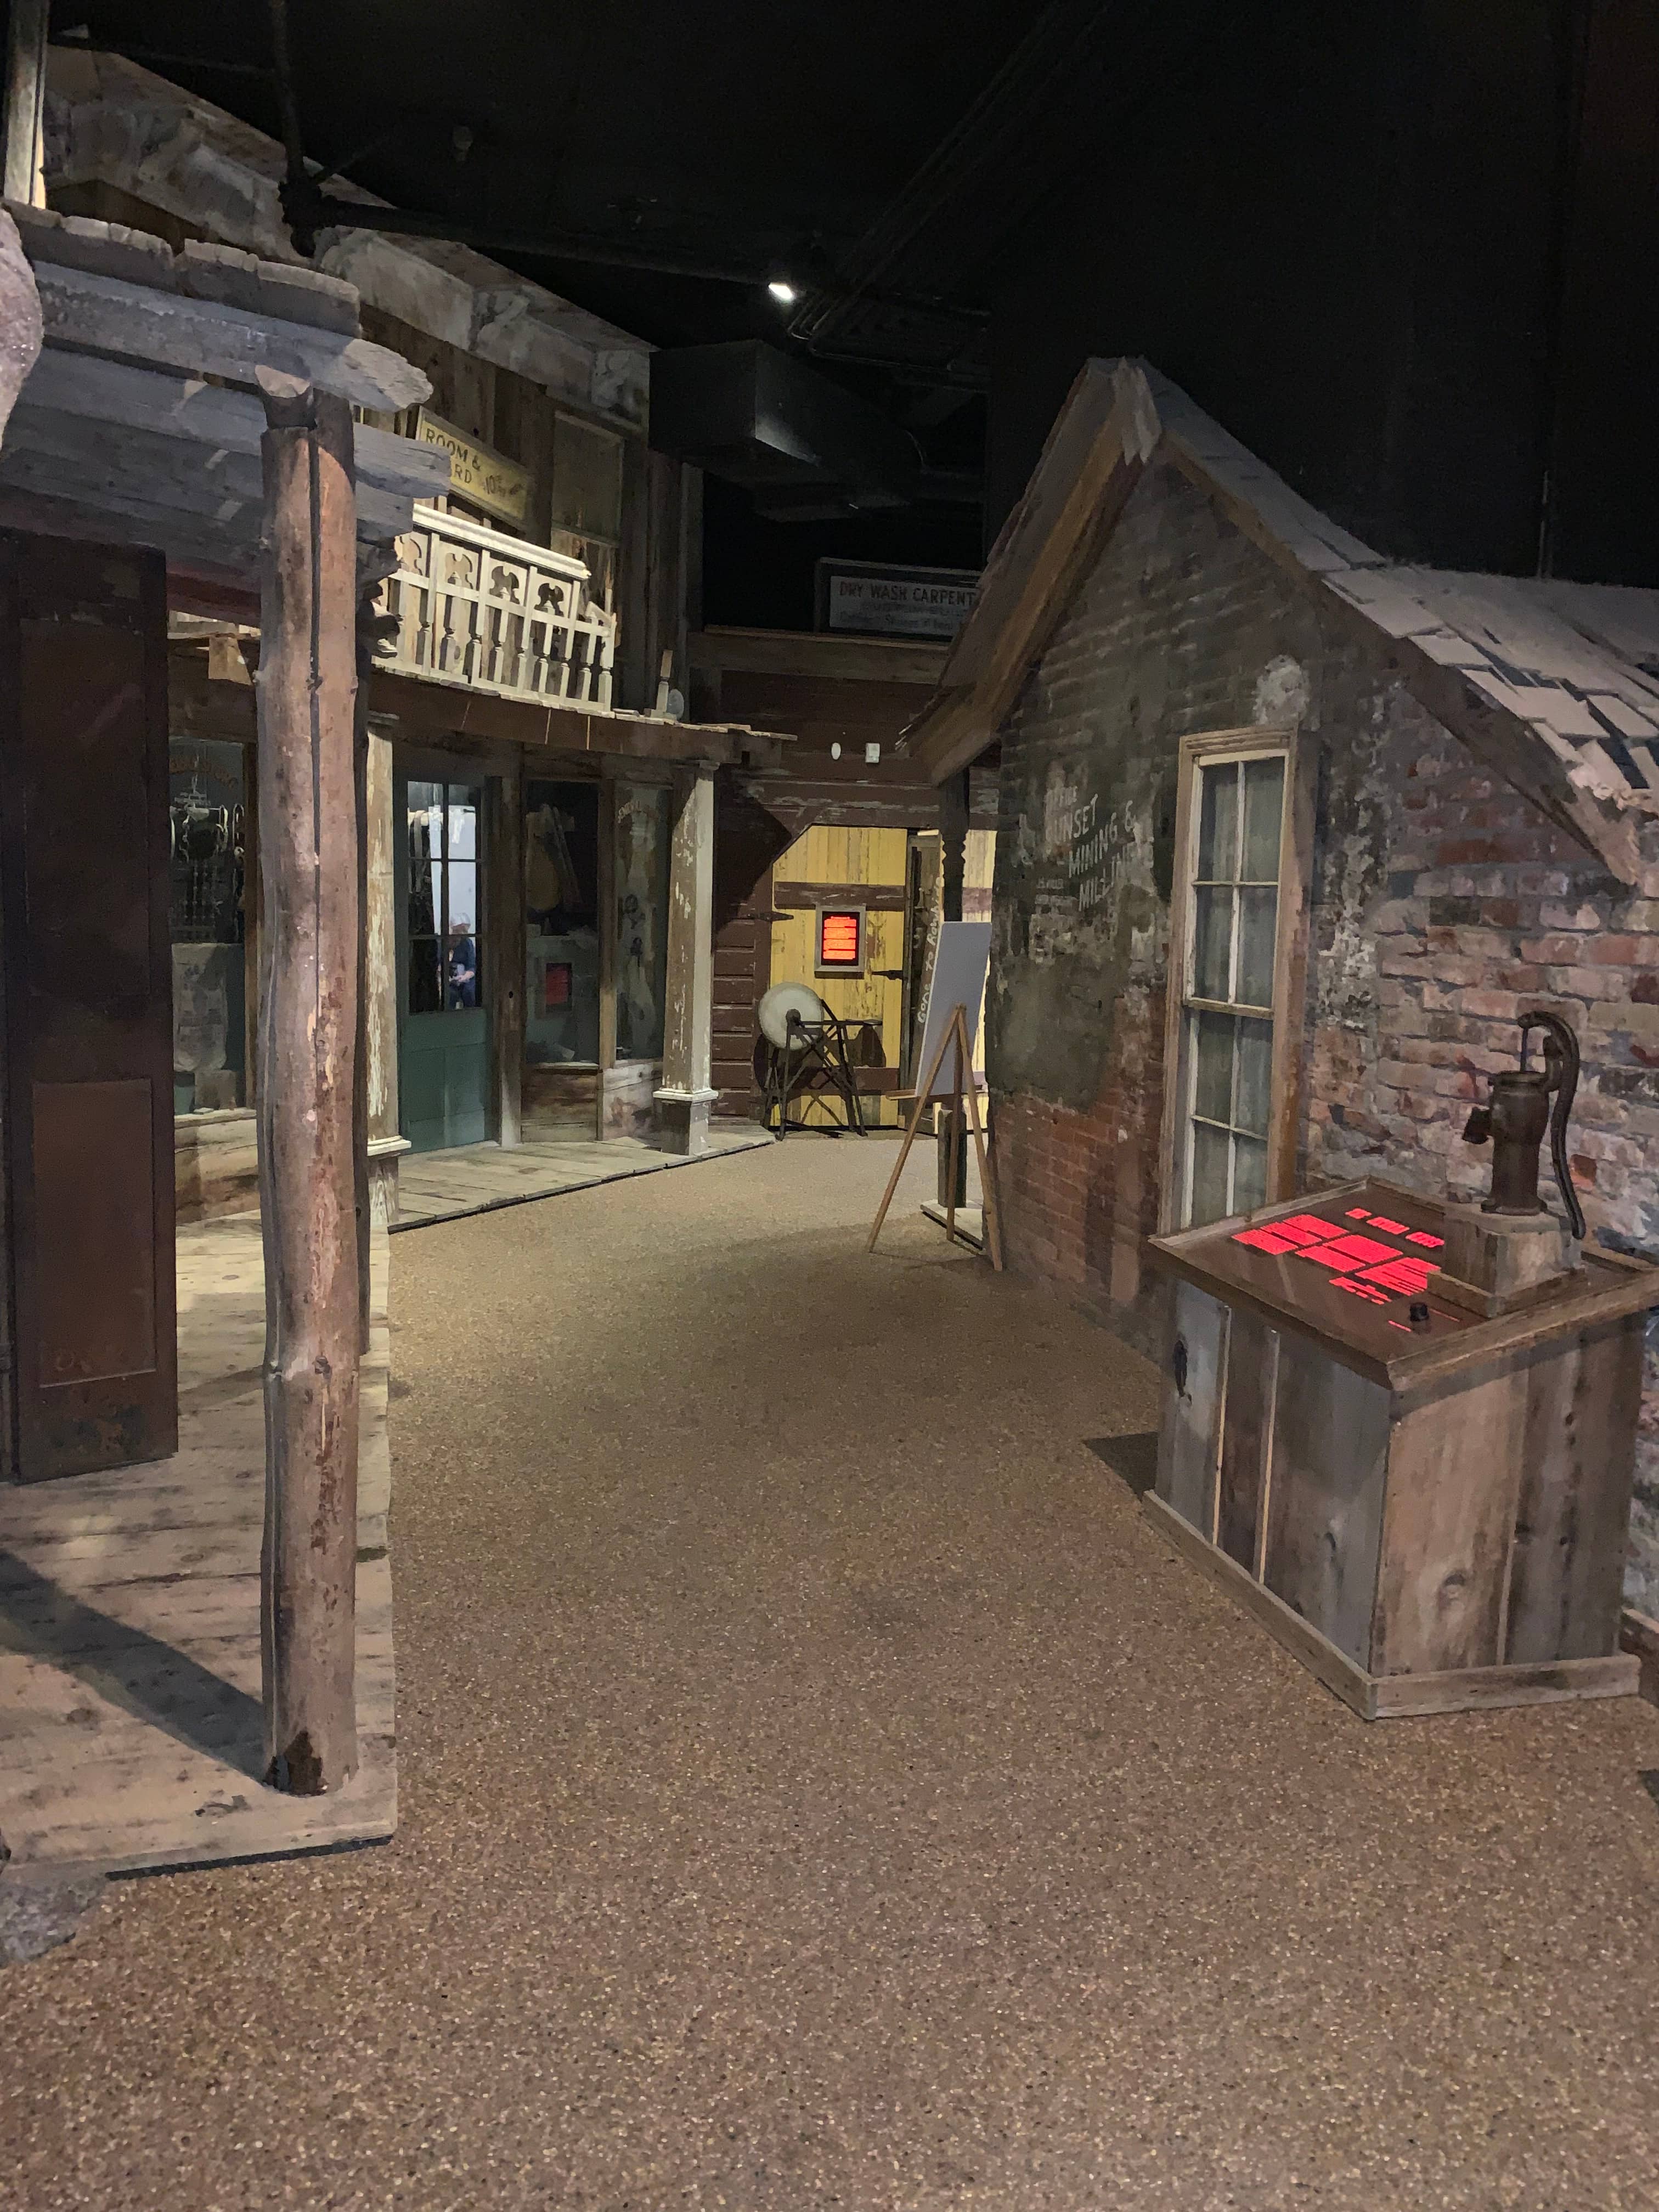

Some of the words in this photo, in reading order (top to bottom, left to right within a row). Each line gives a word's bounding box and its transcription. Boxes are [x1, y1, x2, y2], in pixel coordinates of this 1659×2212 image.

[426, 428, 469, 462] ROOM
[472, 454, 481, 471] &
[839, 581, 863, 599] DRY
[870, 583, 907, 602] WASH
[912, 587, 977, 606] CARPENT
[1069, 812, 1118, 878] MINING
[1124, 800, 1136, 832] &
